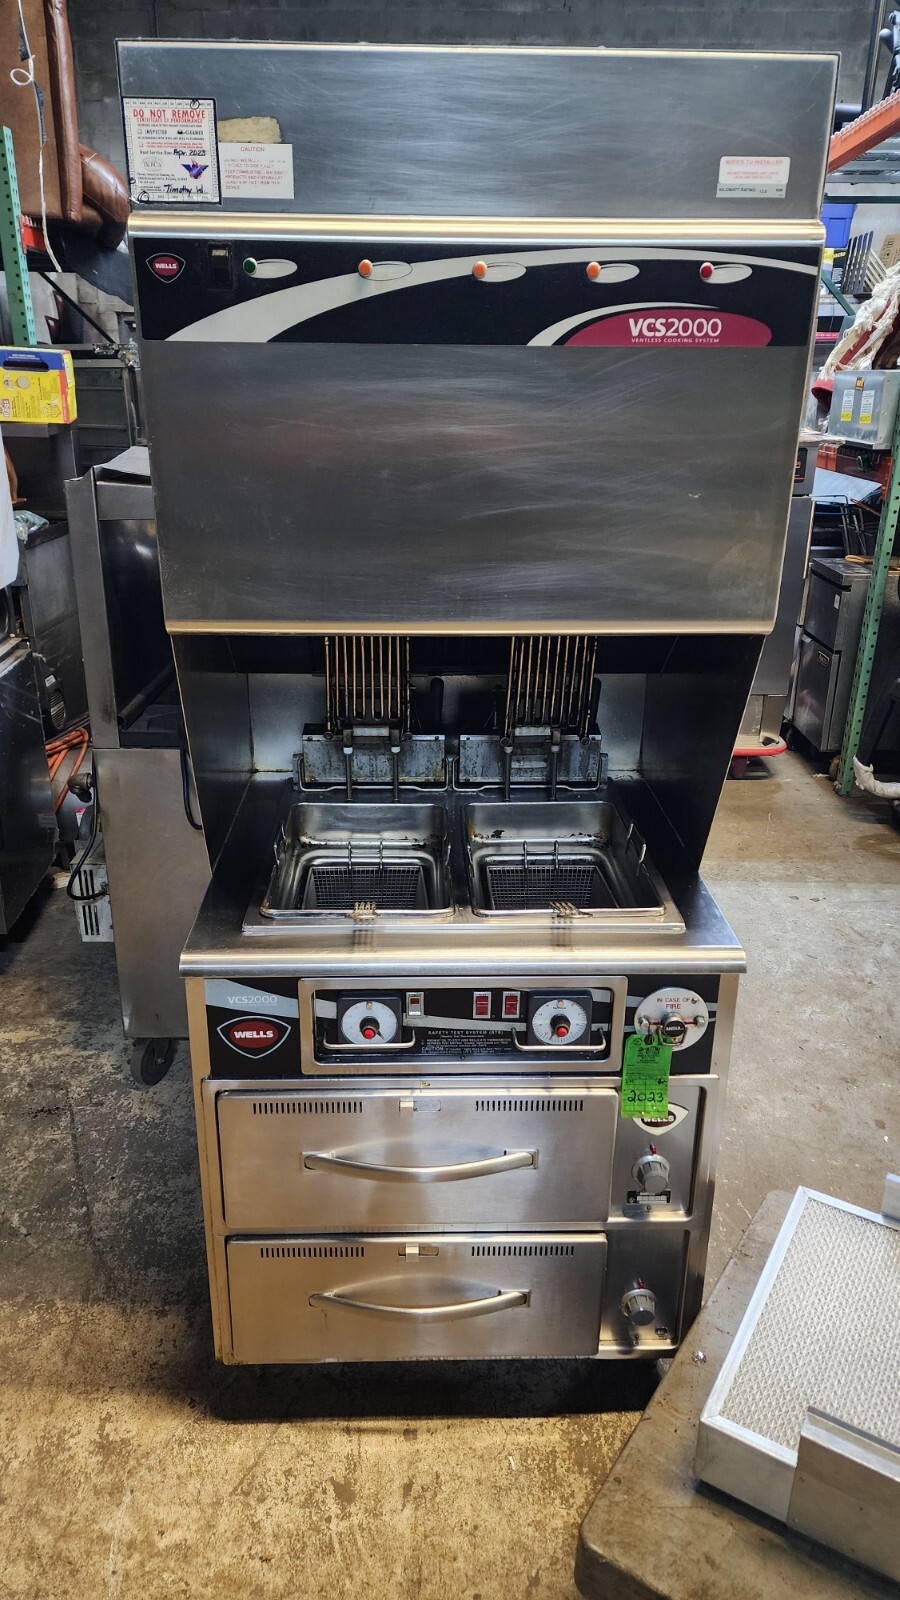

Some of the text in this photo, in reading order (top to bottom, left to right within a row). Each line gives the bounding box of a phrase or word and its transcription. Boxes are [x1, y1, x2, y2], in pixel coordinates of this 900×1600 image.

[133, 109, 205, 119] DO NOT REMOVE
[628, 318, 722, 337] VCS2000
[227, 995, 278, 1004] VCS2000
[233, 1030, 274, 1039] WELLS
[627, 1090, 664, 1103] 2023
